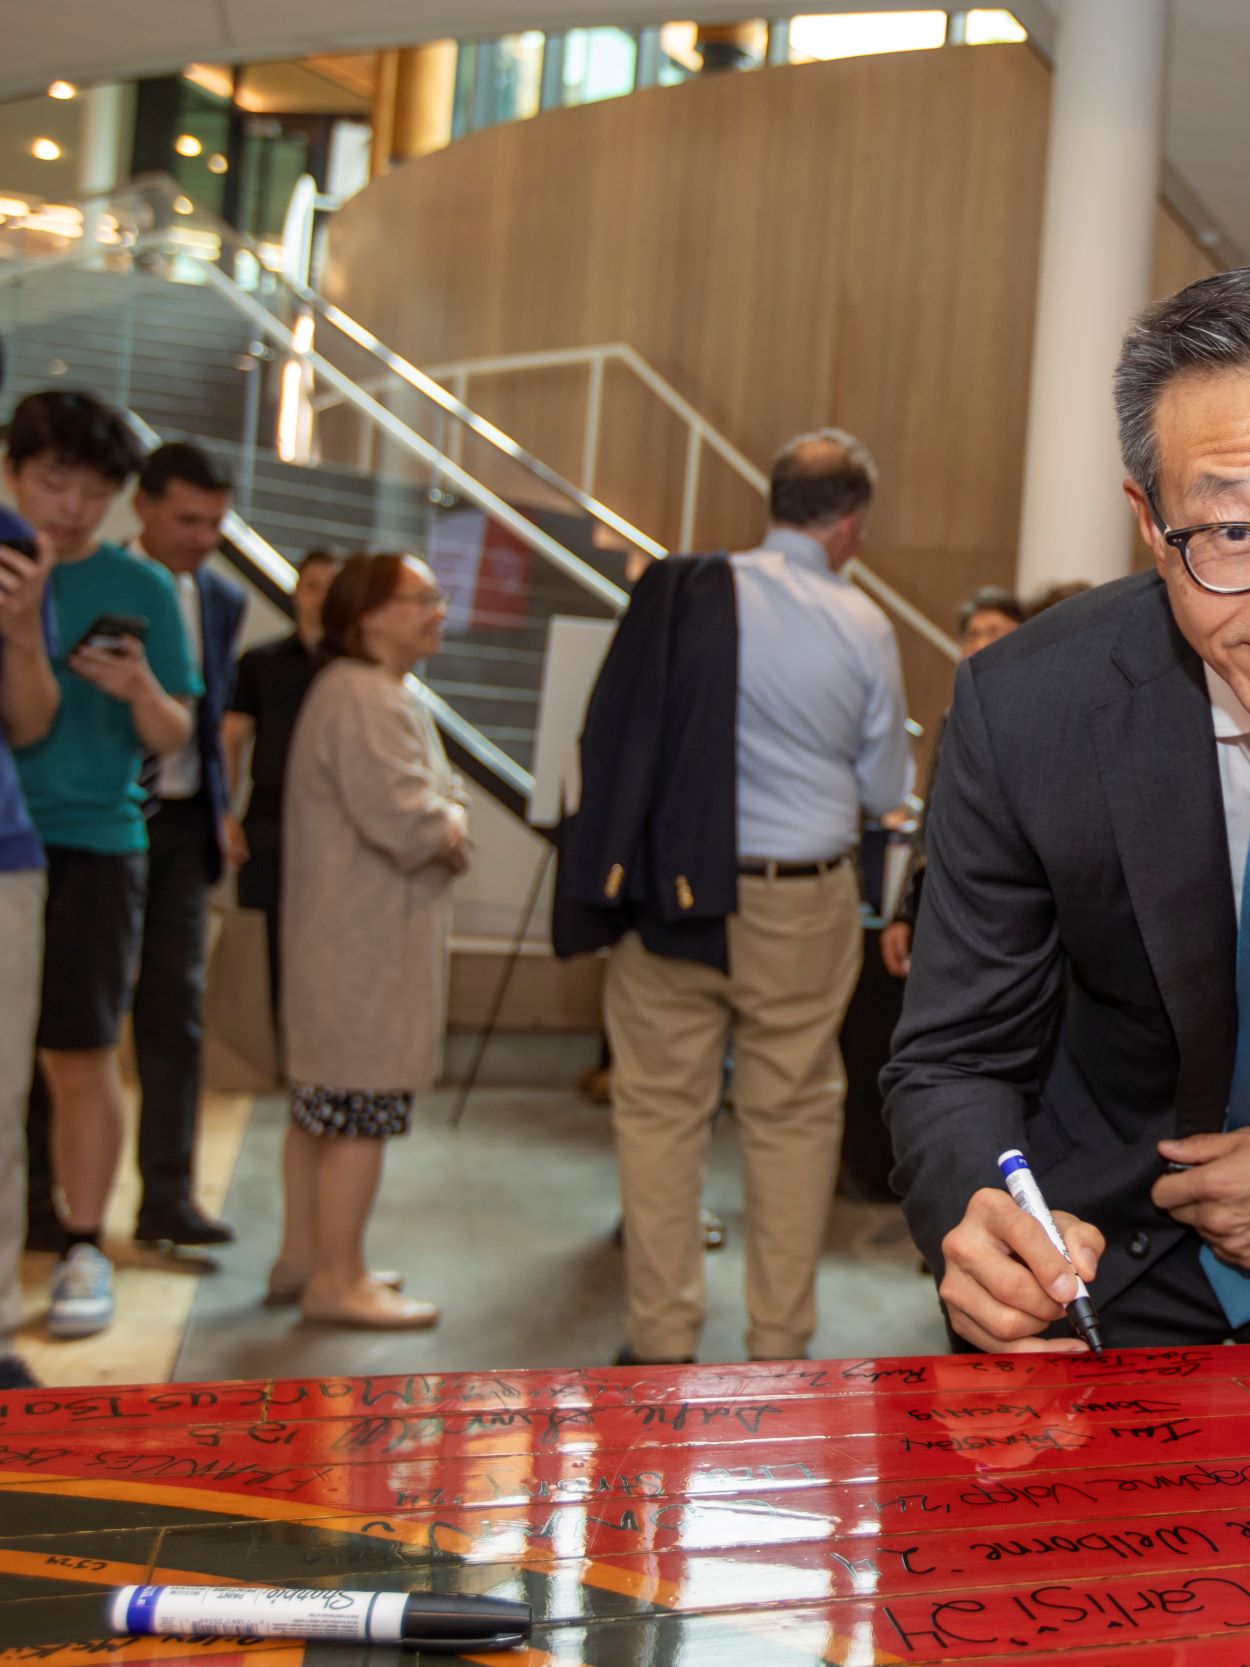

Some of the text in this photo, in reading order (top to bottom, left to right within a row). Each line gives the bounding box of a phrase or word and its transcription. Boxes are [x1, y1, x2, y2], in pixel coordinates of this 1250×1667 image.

[148, 1376, 417, 1411] Marcus
[969, 1526, 1219, 1561] Welborne
[259, 1589, 355, 1611] Sharpie
